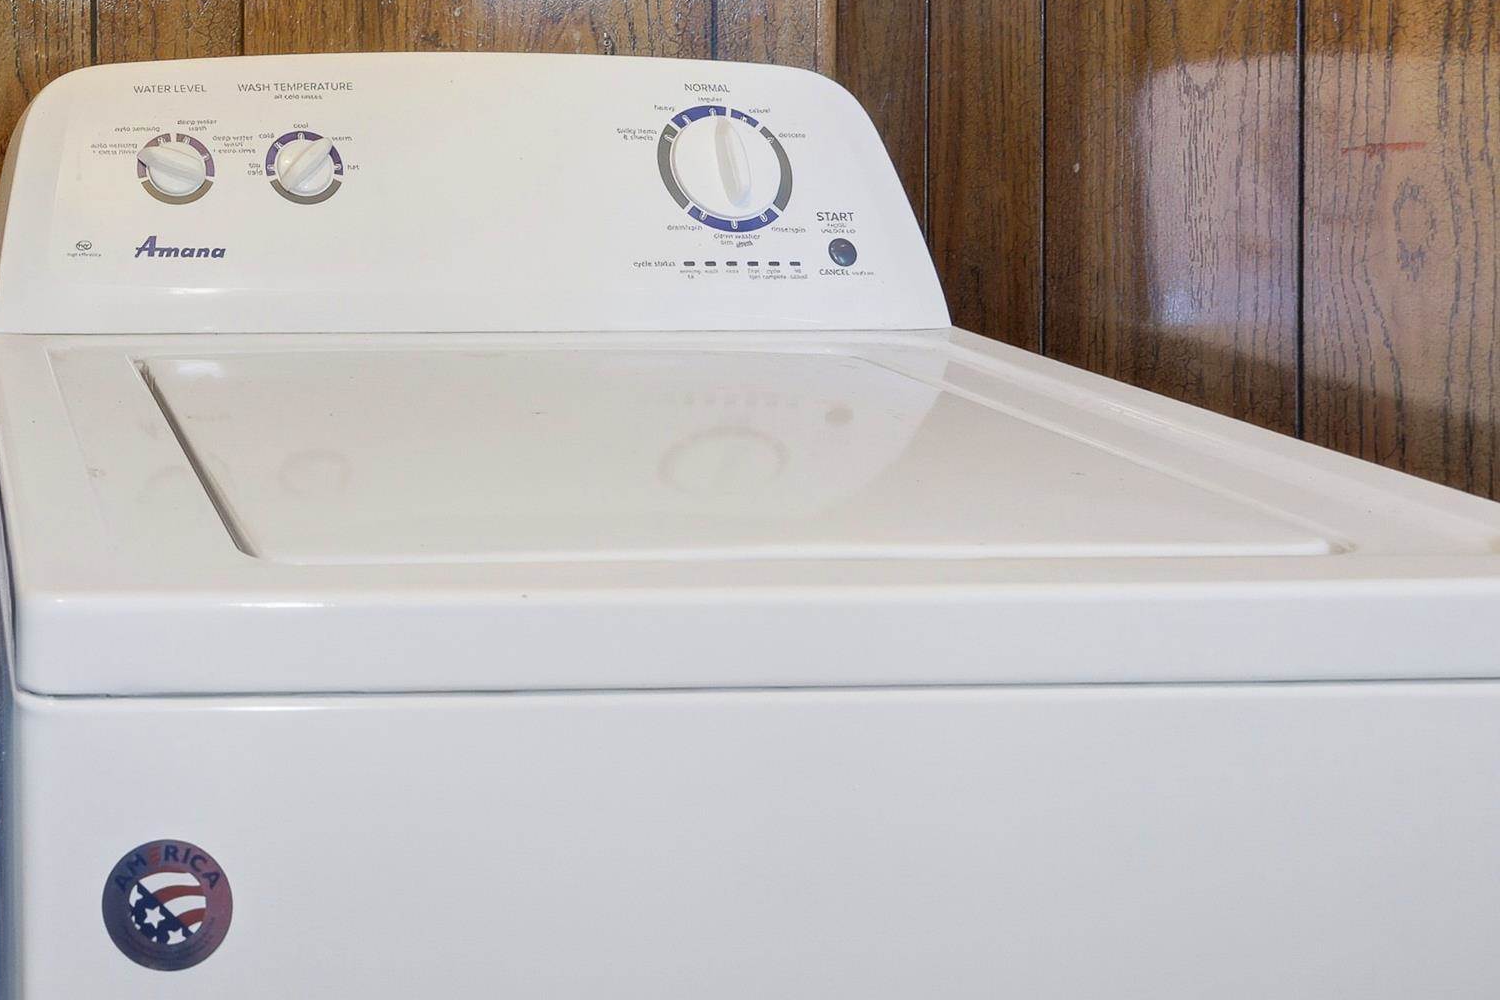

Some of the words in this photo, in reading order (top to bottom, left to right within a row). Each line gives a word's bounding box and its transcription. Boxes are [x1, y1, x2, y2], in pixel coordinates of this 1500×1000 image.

[133, 84, 171, 94] WATER
[173, 84, 207, 93] LEVEL
[237, 83, 270, 93] WASH
[273, 82, 354, 92] TEMPERATURE
[684, 83, 730, 93] NORMAL
[816, 211, 854, 221] START
[134, 235, 226, 258] Amana
[633, 260, 652, 268] cycle
[819, 268, 850, 276] CANCEL
[114, 845, 221, 893] AMERICA
